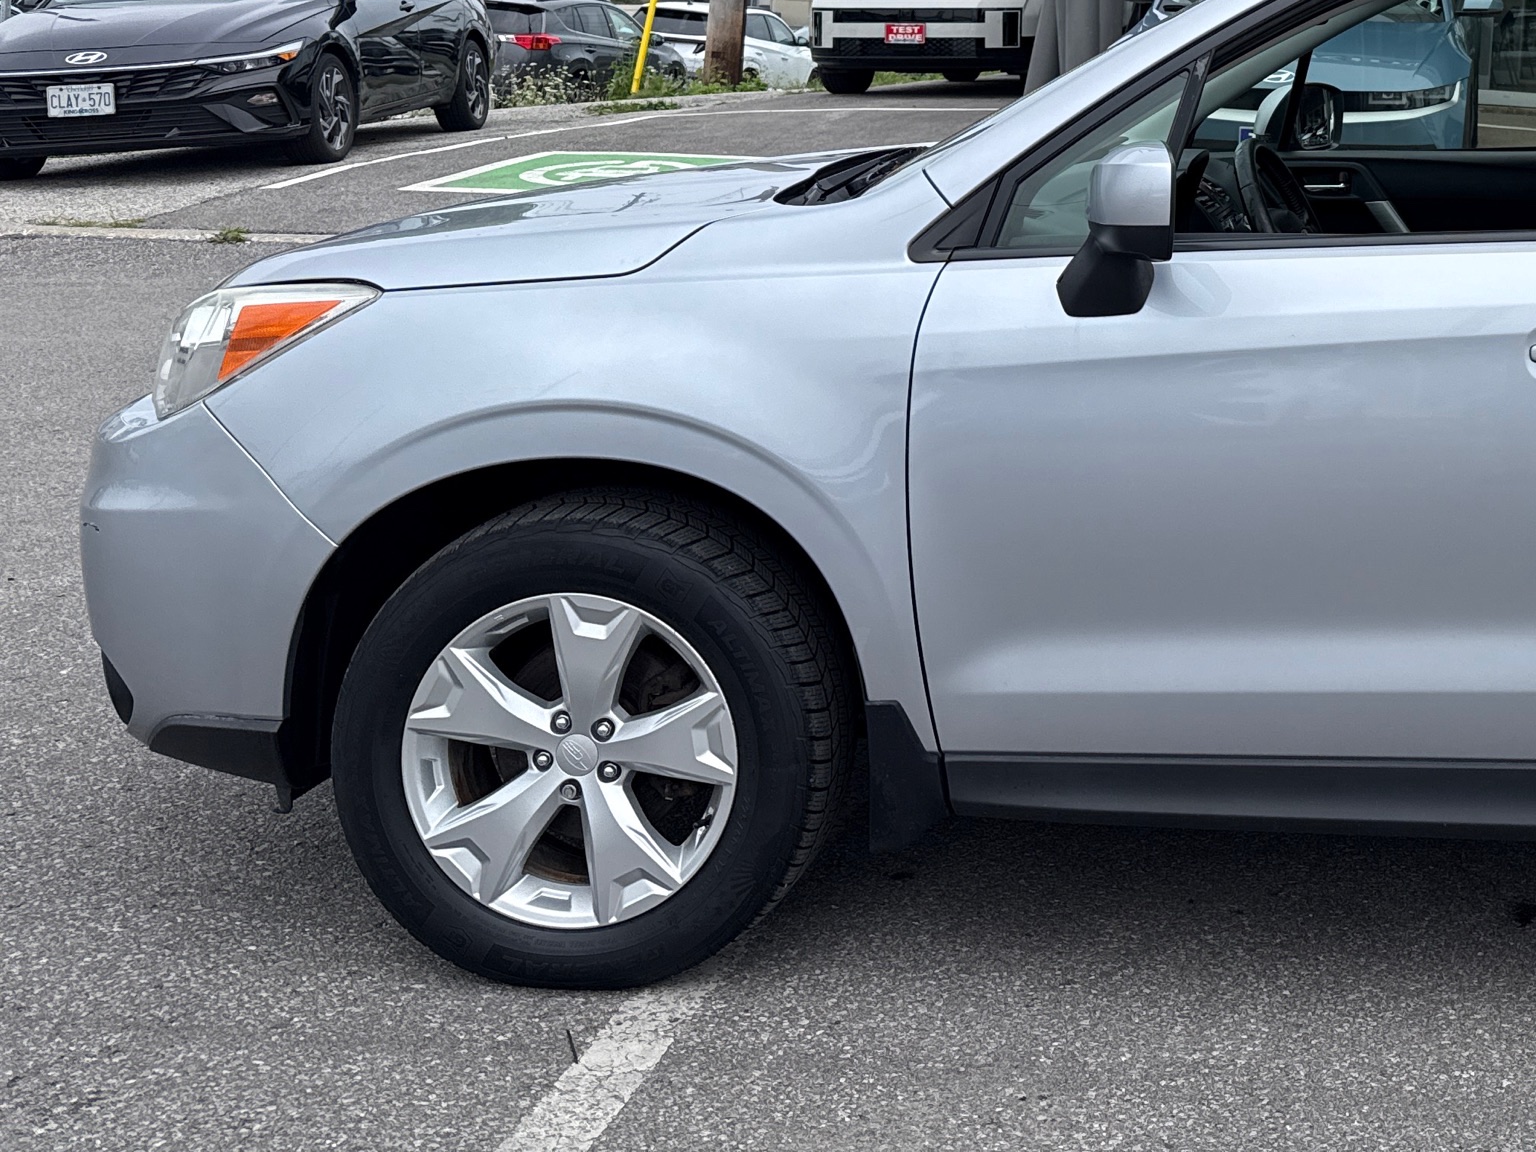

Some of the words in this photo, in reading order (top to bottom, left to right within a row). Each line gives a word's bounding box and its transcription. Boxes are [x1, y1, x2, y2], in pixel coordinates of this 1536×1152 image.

[890, 26, 920, 34] TEST
[888, 33, 923, 42] DRIVE
[50, 93, 80, 109] CLAY
[88, 91, 111, 108] 570
